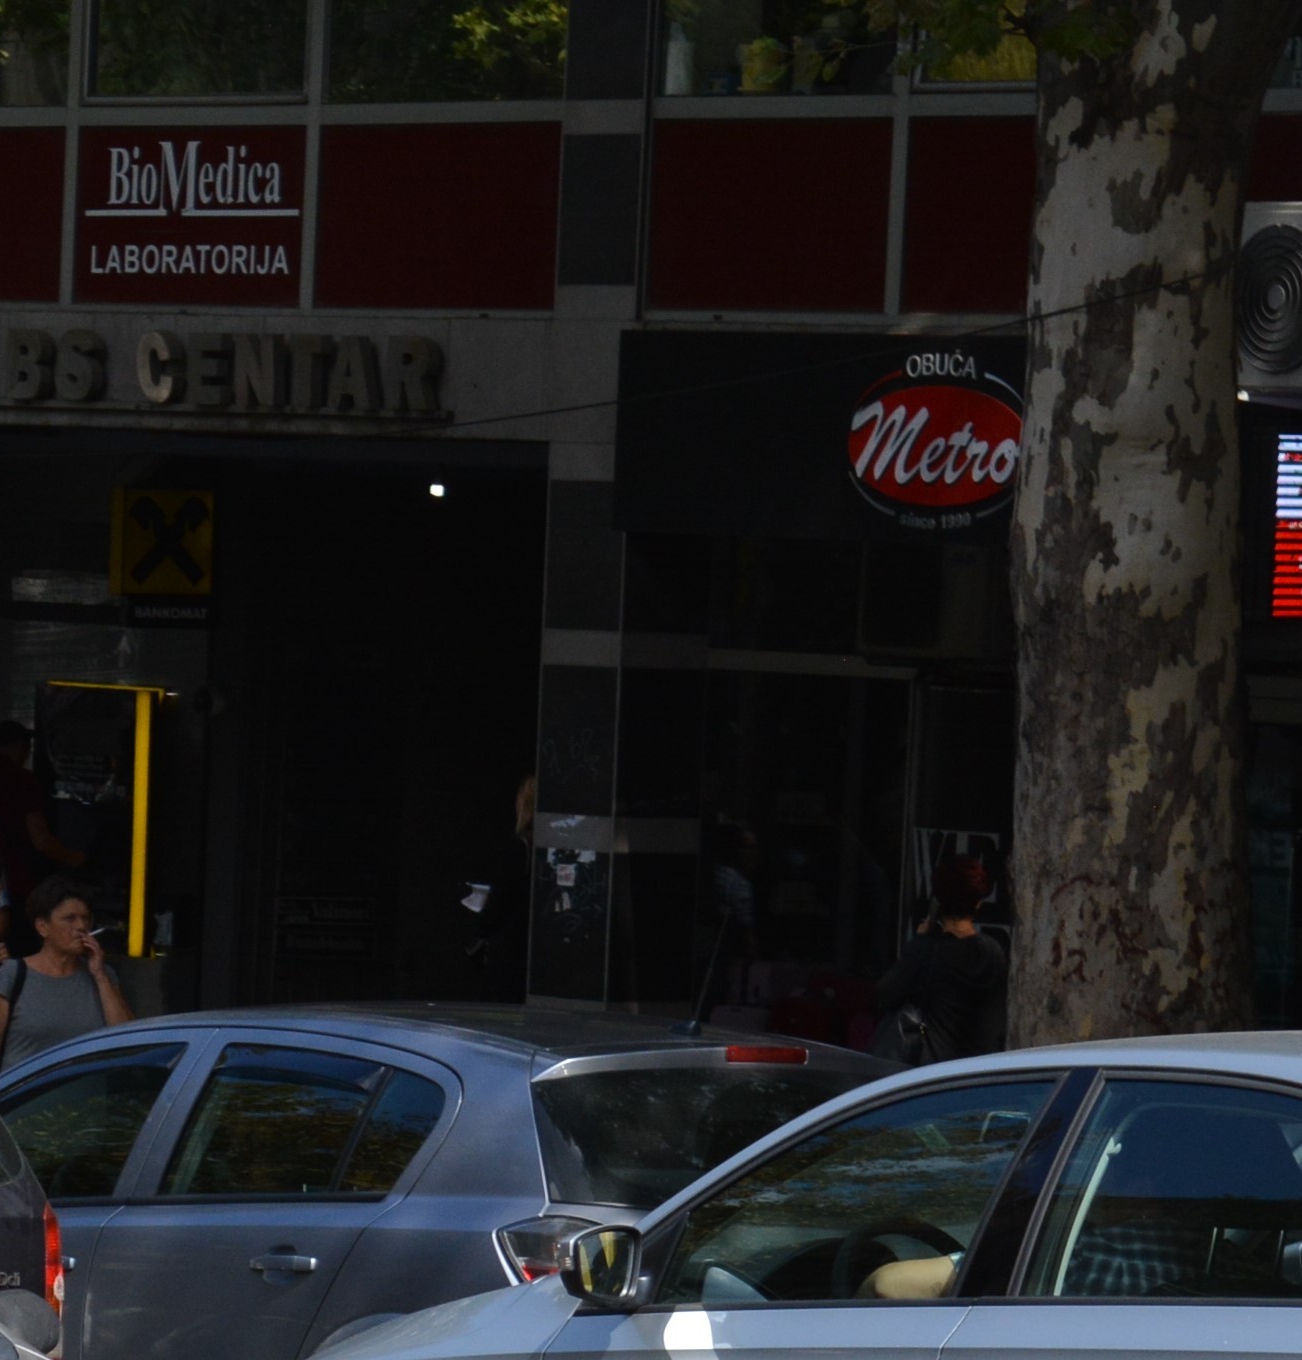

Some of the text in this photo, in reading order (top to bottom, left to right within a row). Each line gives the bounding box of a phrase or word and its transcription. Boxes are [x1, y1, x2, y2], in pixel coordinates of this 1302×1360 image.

[106, 140, 282, 212] BioMedica
[90, 244, 289, 275] LABORATORIJA
[137, 330, 446, 412] CENTAR
[851, 399, 1021, 486] Metro
[134, 606, 208, 620] BANKOMAT
